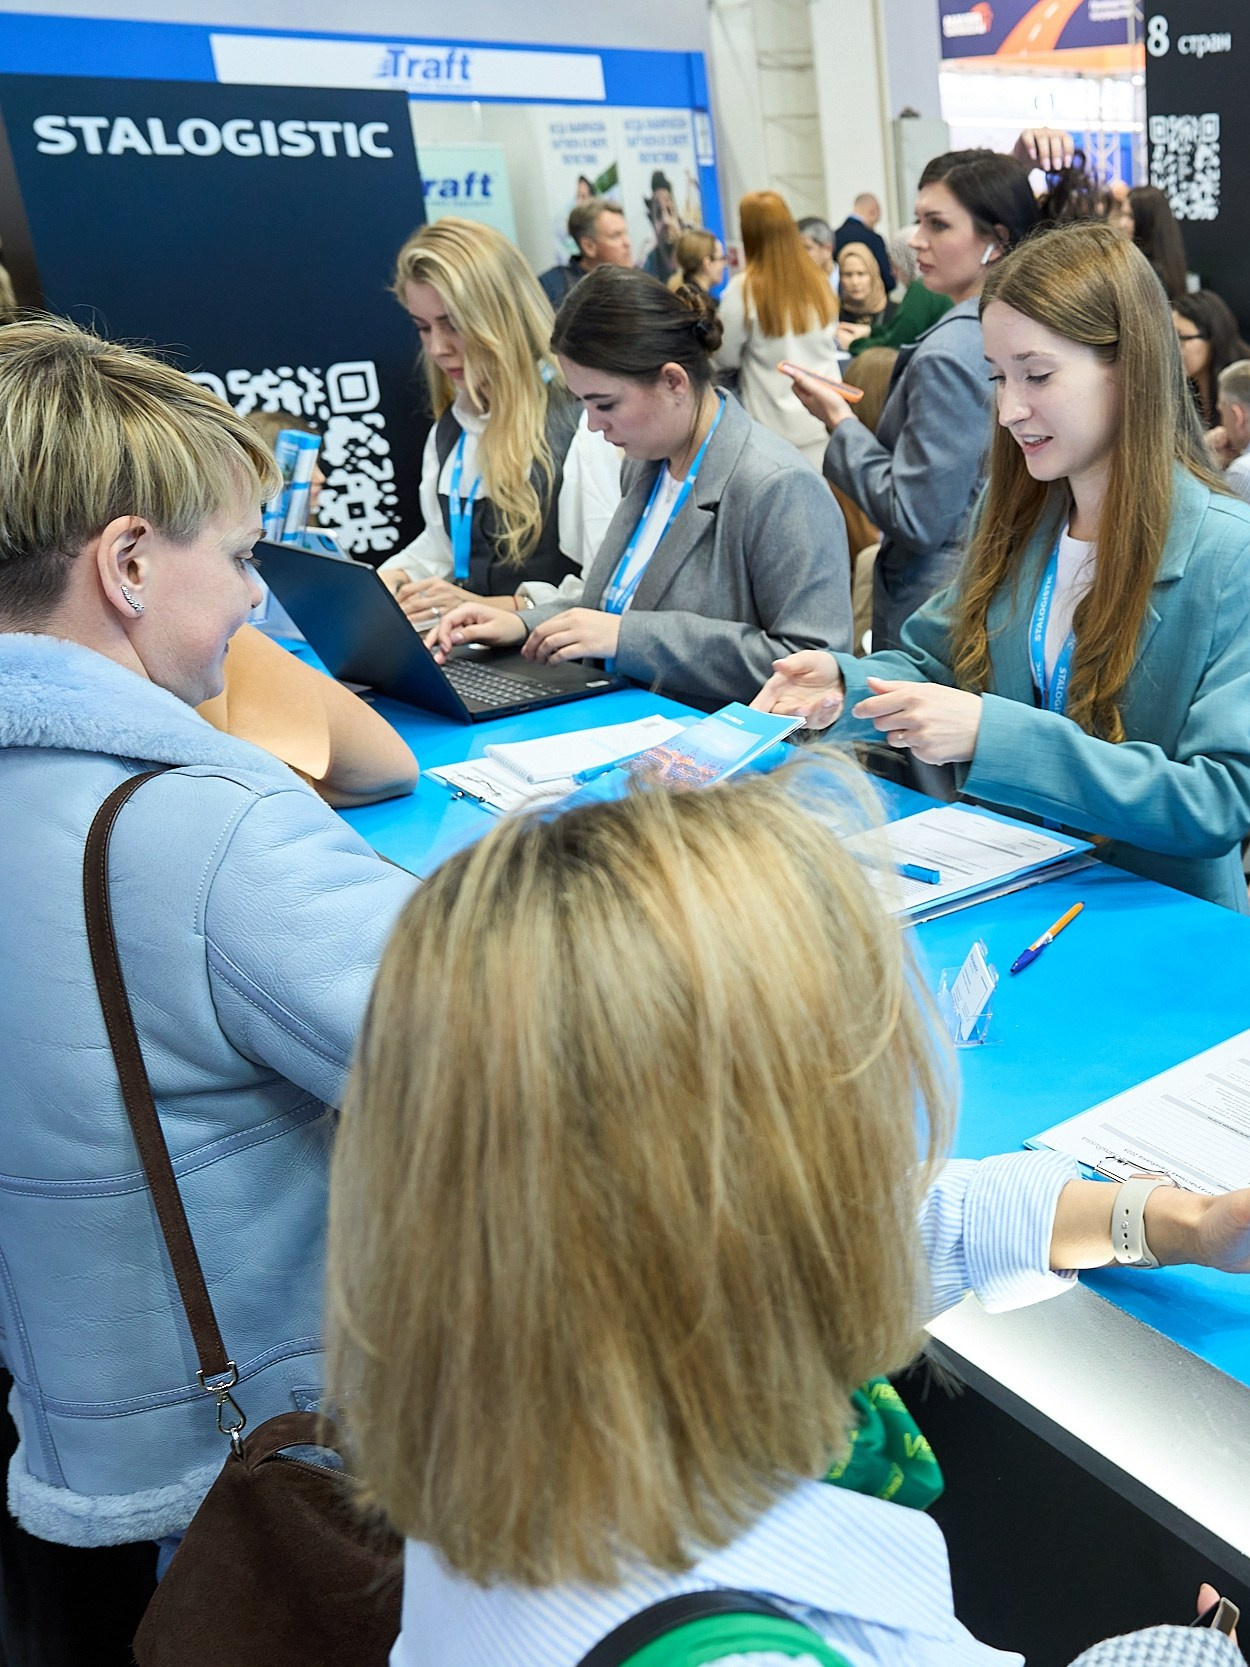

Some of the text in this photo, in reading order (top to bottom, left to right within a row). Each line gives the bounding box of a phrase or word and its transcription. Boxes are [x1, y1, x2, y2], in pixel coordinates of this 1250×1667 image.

[1147, 15, 1232, 59] 8 стран
[384, 47, 471, 80] Traft
[33, 115, 394, 158] STALOGISTIC
[421, 172, 491, 197] raft
[1034, 574, 1054, 642] STALOGISTIC
